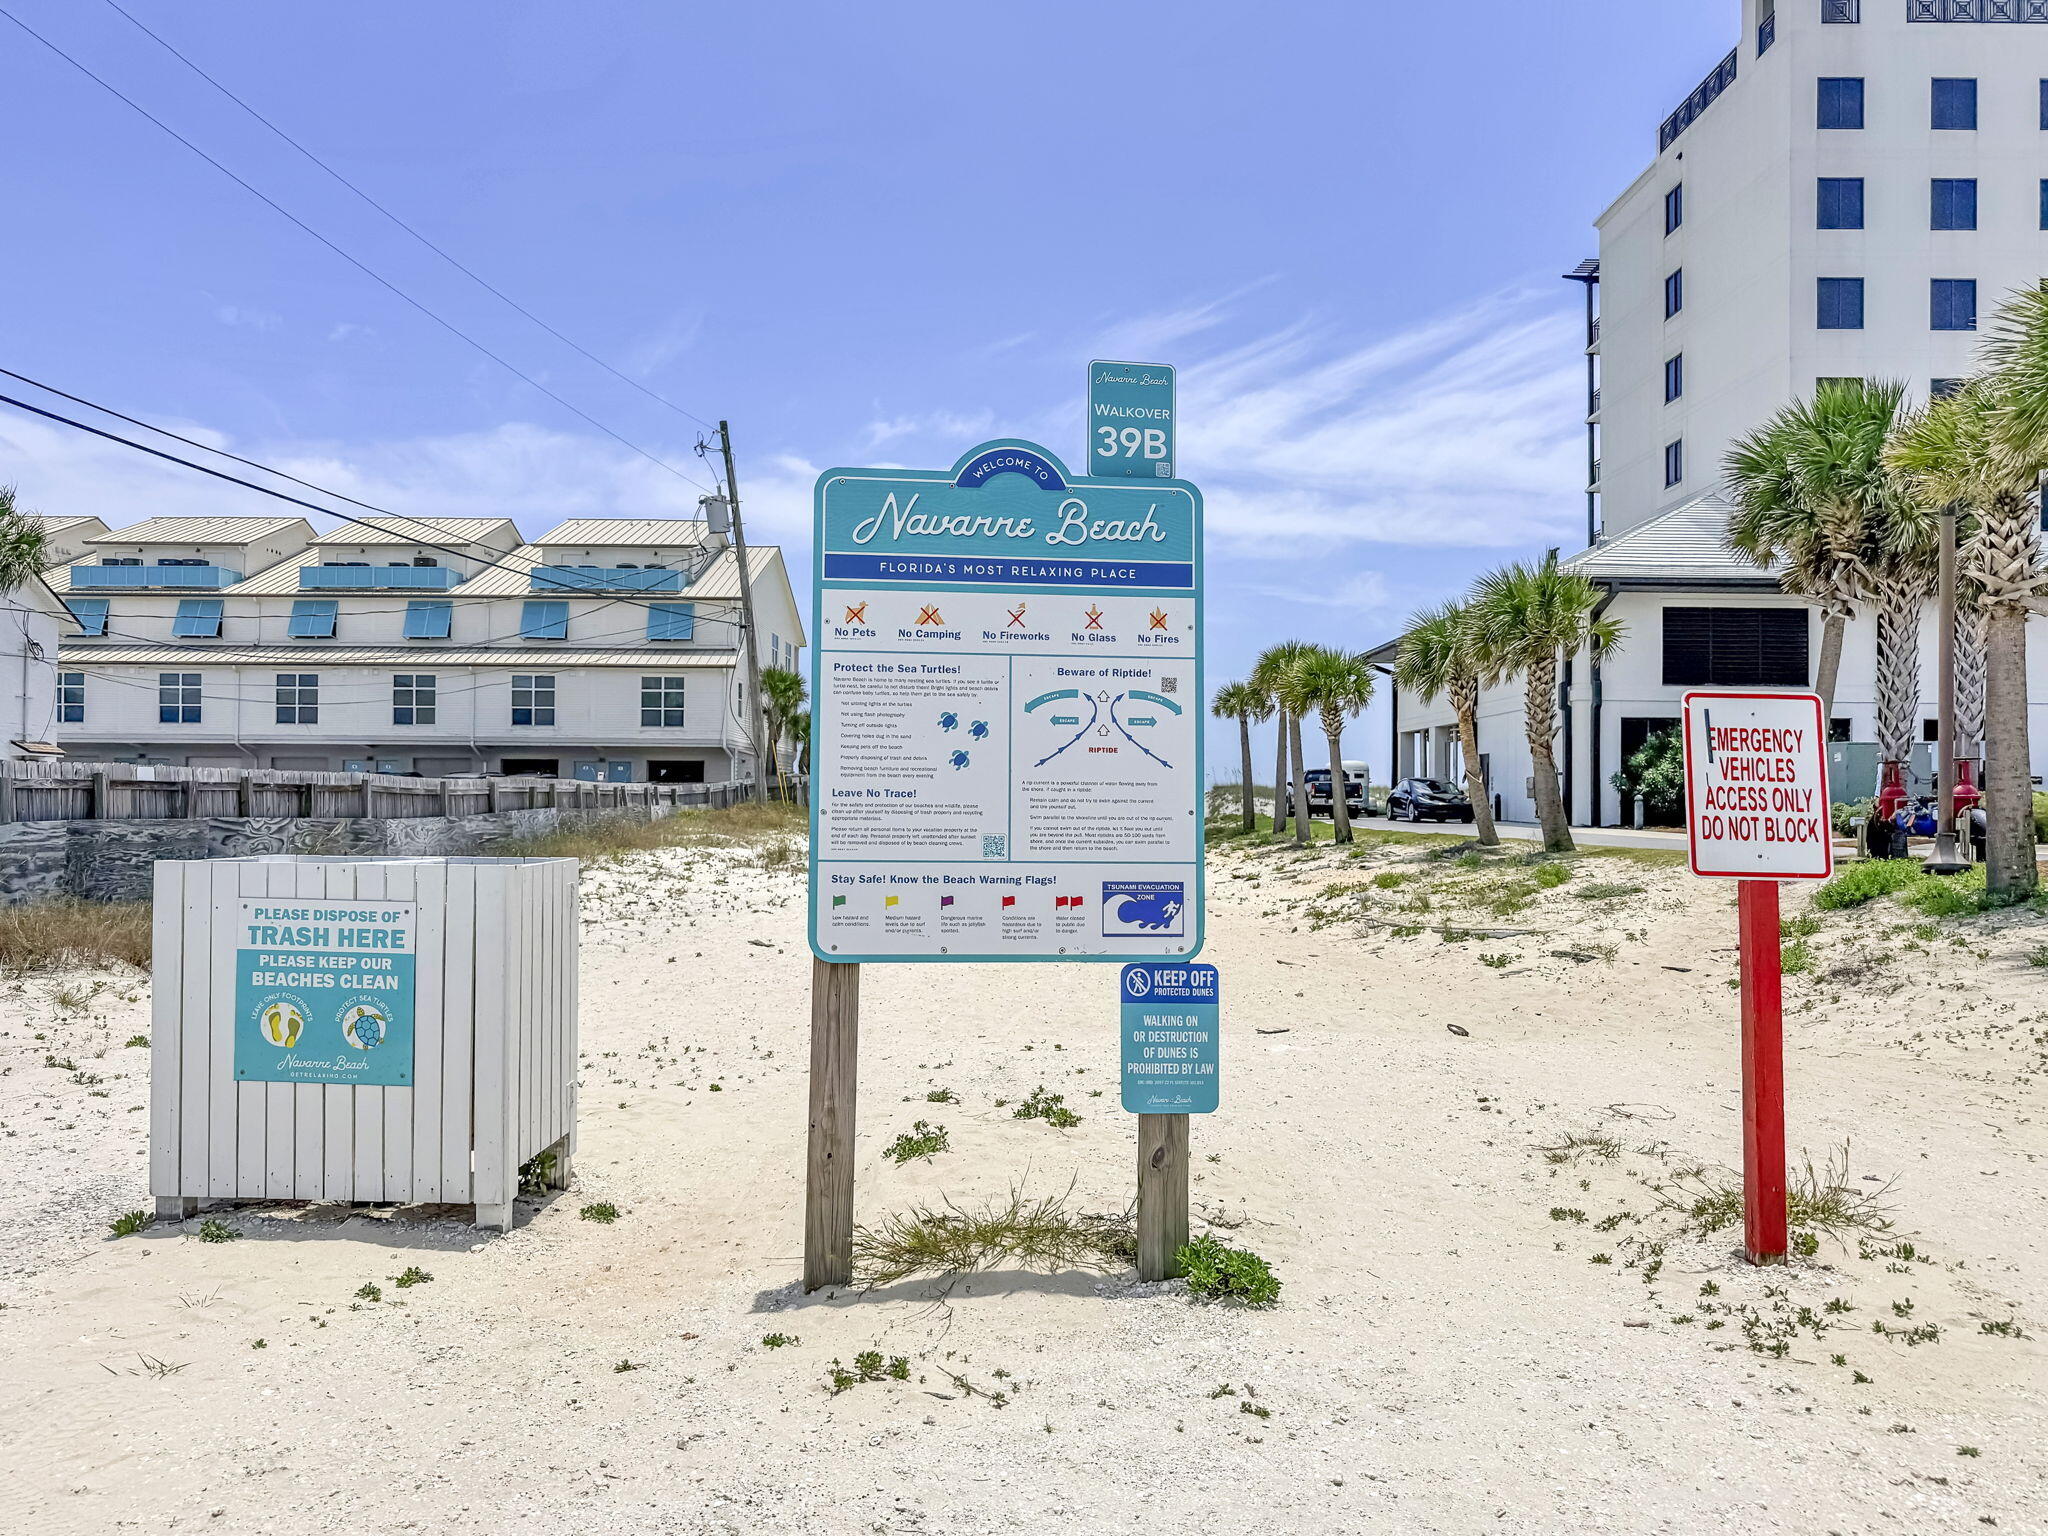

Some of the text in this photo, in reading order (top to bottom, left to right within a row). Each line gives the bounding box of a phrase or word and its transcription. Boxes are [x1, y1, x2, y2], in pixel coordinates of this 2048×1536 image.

[1096, 374, 1168, 386] Navarre Beach
[1095, 404, 1170, 420] WALKOVER
[1097, 427, 1167, 458] 39B
[973, 458, 1049, 481] WELCOME TO
[852, 492, 1166, 546] Navarre Beach
[880, 563, 1136, 579] FLORIDA'S MOST RELAXING PLACE
[834, 628, 876, 638] No Pets
[898, 629, 961, 641] No Camping
[982, 631, 1050, 641] No Fireworks
[1071, 633, 1116, 643] No Glass
[1137, 634, 1179, 644] No Fires
[834, 663, 960, 674] Protect the Sea Turtles!
[1058, 668, 1152, 678] Beware of Riptide!
[1709, 727, 1803, 753] EMERGENCY
[1720, 758, 1795, 782] VEHICLES
[832, 789, 862, 797] Leave
[884, 790, 916, 798] Trace!
[1706, 787, 1812, 812] ACCESS ONLY
[1702, 816, 1819, 842] DO NOT BLOCK
[831, 874, 1057, 886] Stay Safe! Know the Beach Warning Flags!
[255, 908, 400, 923] PLEASE DISPOSE OF
[248, 926, 405, 948] TRASH HERE
[260, 955, 392, 970] PLEASE KEEP OUR
[252, 972, 398, 990] BEACHES CLEAN
[1155, 970, 1214, 987] KEEP OFF
[251, 992, 313, 1021] LEAVE ONLY FOOTPRINTS
[335, 996, 358, 1022] PROTECT
[373, 997, 394, 1022] TURTLES
[1144, 1016, 1198, 1026] WALKING ON
[1134, 1032, 1208, 1042] OR DESTRUCTION
[1144, 1048, 1198, 1058] OF DUNES IS
[278, 1054, 369, 1070] Navarre Beach
[1128, 1063, 1214, 1074] PROHIBITED BY LAW
